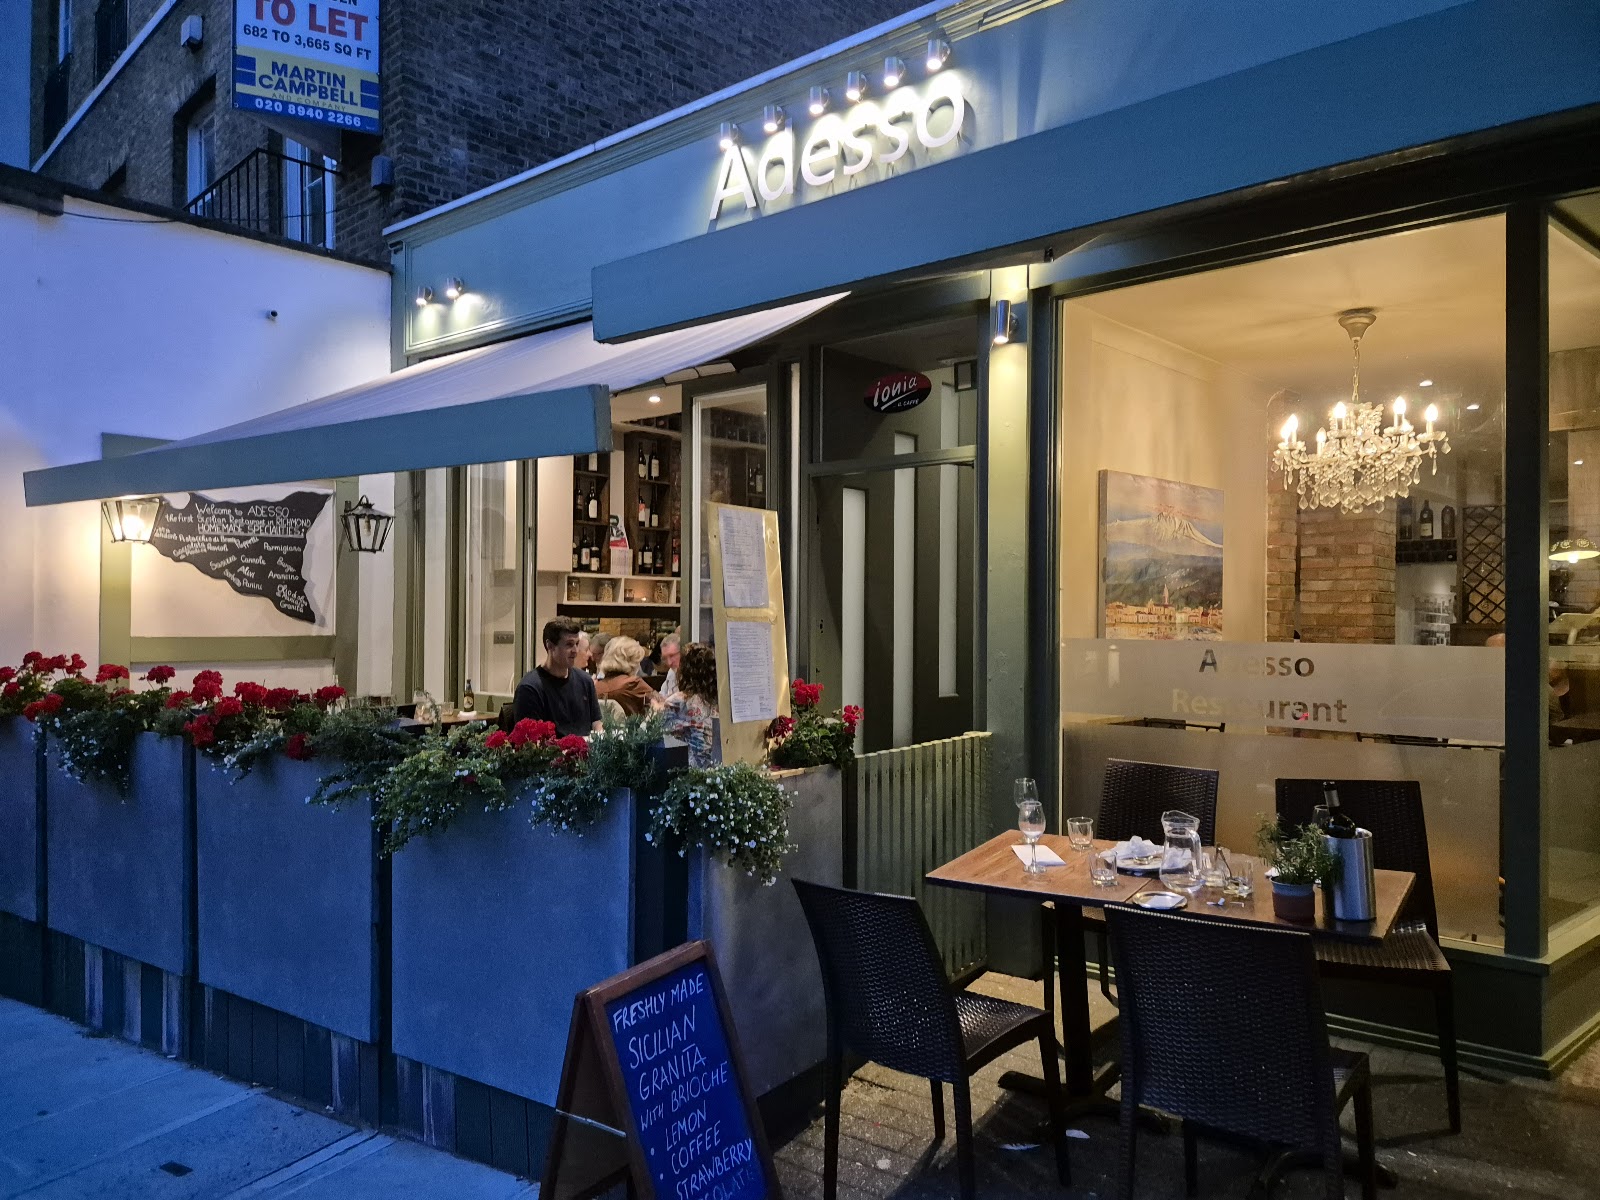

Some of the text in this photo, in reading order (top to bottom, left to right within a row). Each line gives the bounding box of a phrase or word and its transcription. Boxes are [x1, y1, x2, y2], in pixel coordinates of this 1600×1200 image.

[254, 0, 369, 42] TO LET
[243, 24, 372, 60] 682 TO 3,665 SQ FT
[258, 74, 359, 106] CAMPBELL
[271, 61, 346, 89] MARTIN
[255, 98, 362, 127] 020 8940 2266
[271, 92, 346, 111] AND COMPANY
[709, 72, 966, 220] Adesso
[165, 513, 178, 523] the
[178, 513, 194, 523] first
[196, 513, 227, 524] Sicilian
[275, 516, 312, 529] RICHMOND
[195, 503, 290, 518] Welcome to ADESSO
[197, 523, 244, 534] HOMEMADE
[1198, 648, 1316, 678] Aesso
[613, 973, 705, 1034] FRESHLY MADE
[628, 1004, 697, 1070] SICILIAN
[639, 1043, 708, 1101] GRANITA
[640, 1060, 729, 1132] WITH BRIOCHE
[666, 1099, 708, 1152] LEMON
[671, 1119, 722, 1176] COFFEE
[676, 1137, 753, 1200] STRAWBERRY
